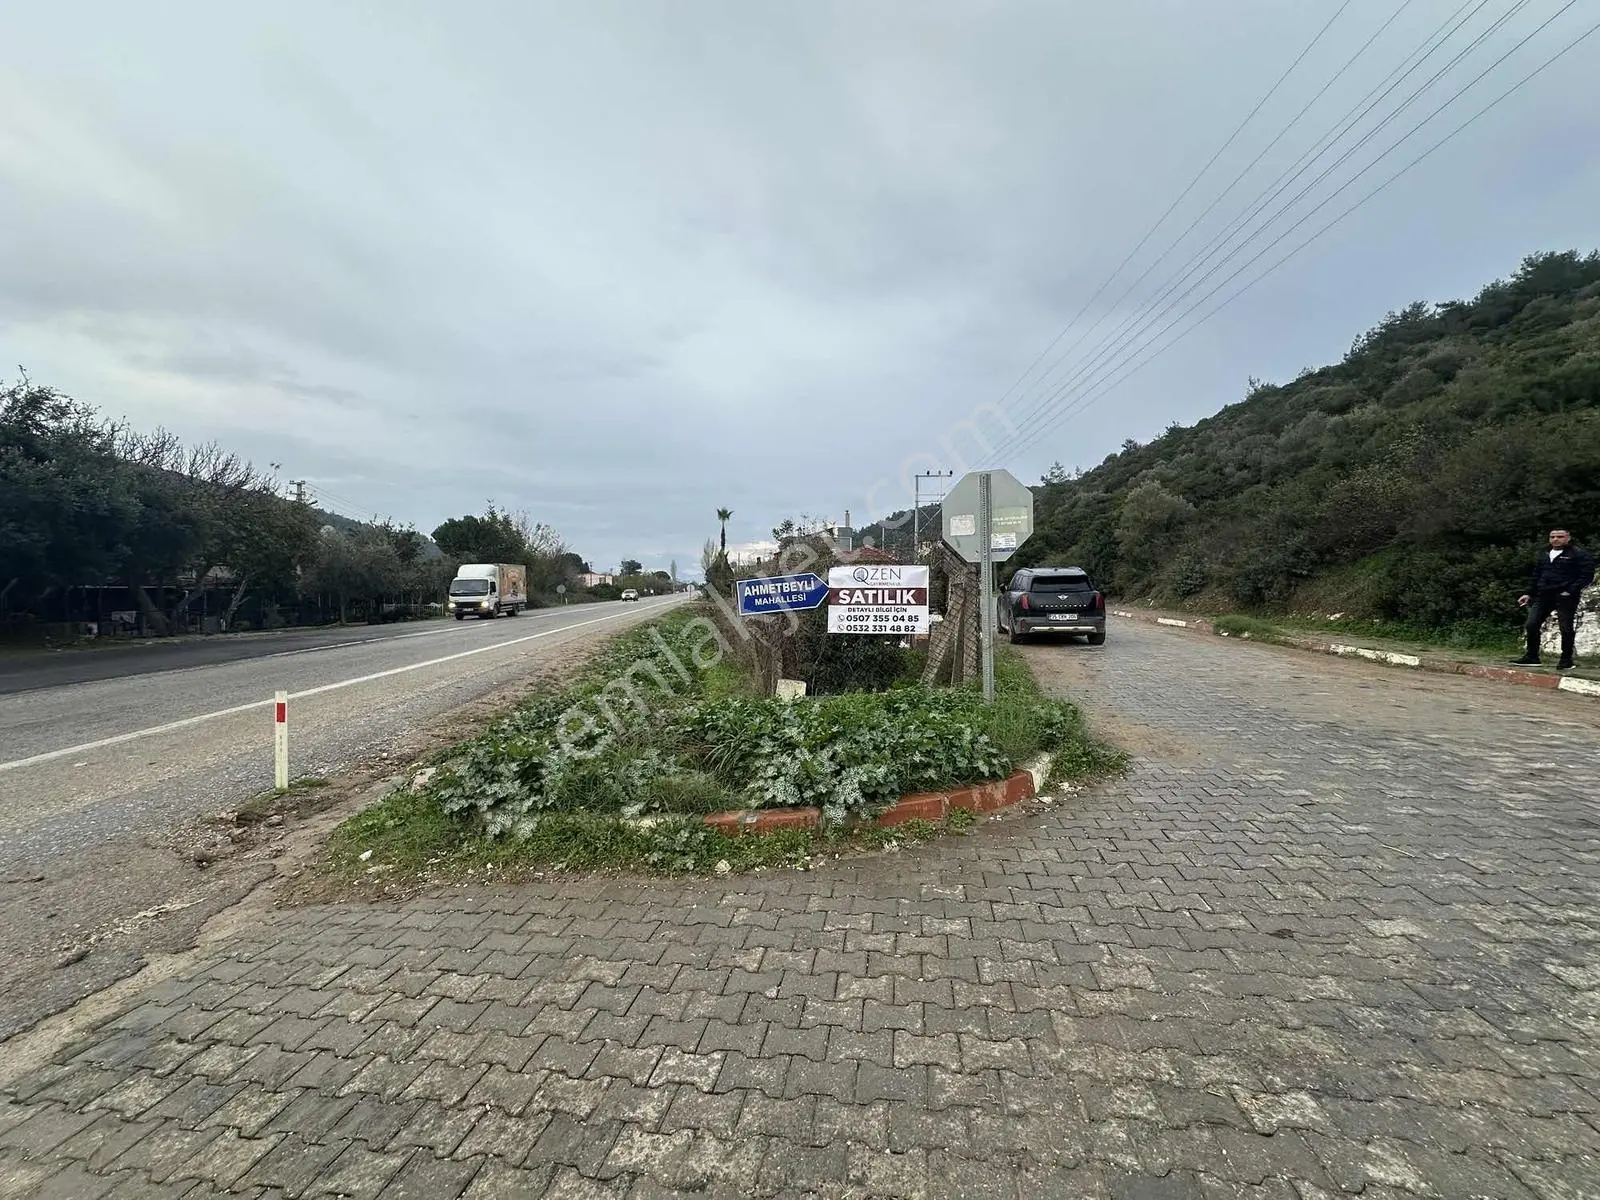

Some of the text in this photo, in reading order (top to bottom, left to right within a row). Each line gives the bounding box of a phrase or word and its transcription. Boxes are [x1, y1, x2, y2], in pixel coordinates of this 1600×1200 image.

[744, 577, 815, 597] AHMETBEYLİ
[754, 593, 806, 606] MAHALLESİ
[838, 589, 917, 605] SATILIK
[893, 606, 908, 614] İÇİN
